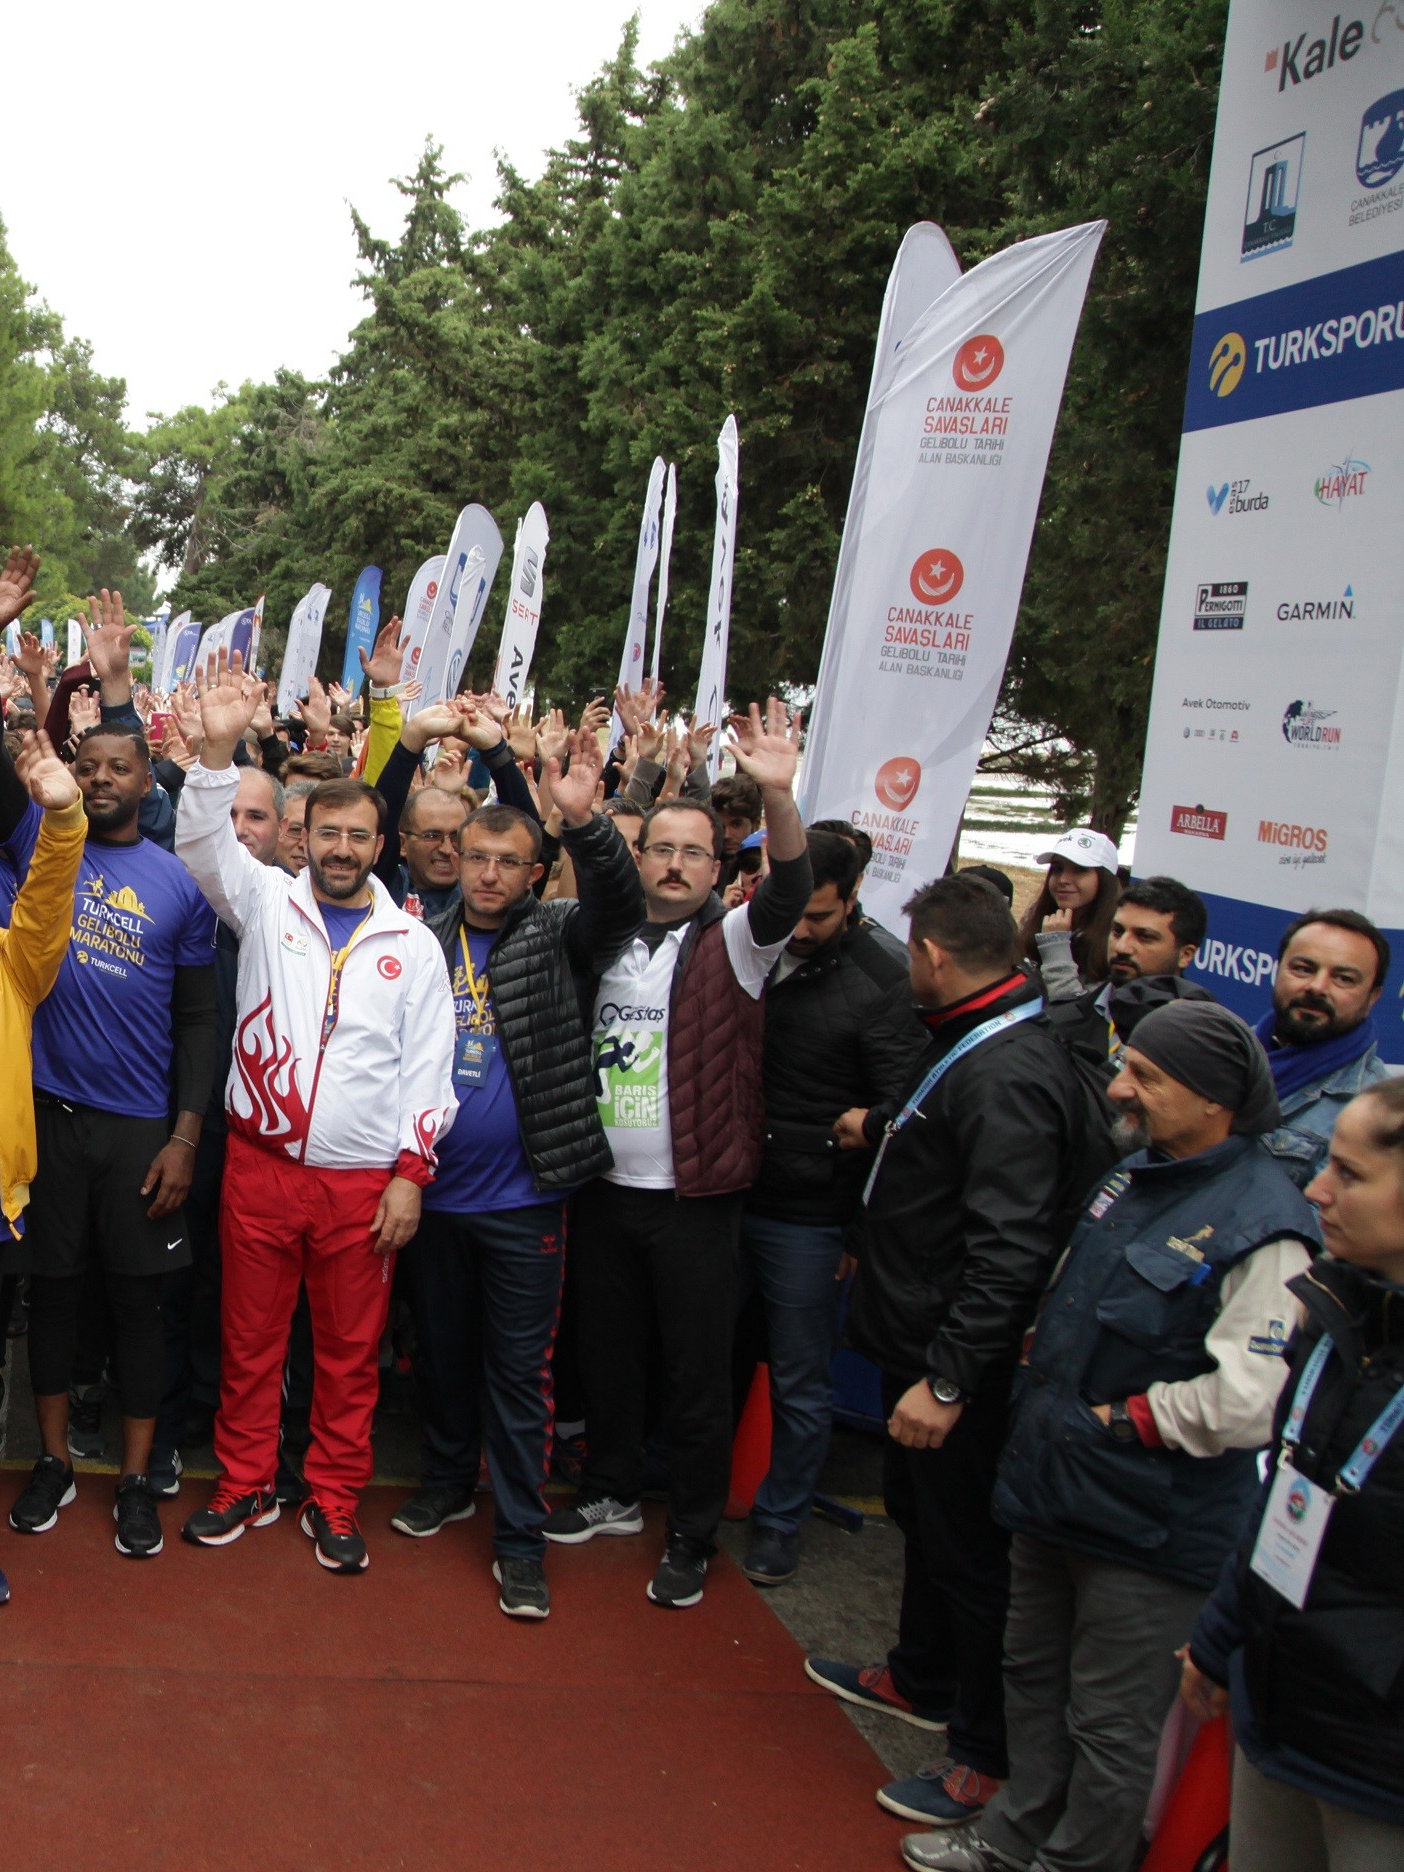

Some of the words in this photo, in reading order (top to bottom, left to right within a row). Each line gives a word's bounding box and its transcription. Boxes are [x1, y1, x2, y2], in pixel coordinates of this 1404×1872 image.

[1278, 14, 1365, 93] Kale
[923, 415, 1008, 435] SAVAŞLARI
[919, 437, 968, 449] GELİBOLU
[974, 438, 1004, 451] TARİHİ
[918, 453, 942, 464] ALAN
[1237, 479, 1251, 494] 17
[1320, 471, 1368, 500] HAYAT
[1235, 491, 1270, 513] burda
[1219, 585, 1239, 594] 1860
[1277, 600, 1354, 621] GARMIN
[1208, 619, 1239, 628] GELATO
[884, 625, 970, 652] SAVAŞLARI
[880, 645, 931, 662] GELİBOLU
[937, 651, 966, 667] TARİHİ
[878, 660, 903, 673] ALAN
[1181, 697, 1203, 709] Avek
[1205, 698, 1251, 711] Otomotiv
[1177, 813, 1220, 833] ARBELLA
[82, 897, 144, 935] TURKCELL
[69, 926, 145, 966] MARATONU
[91, 957, 128, 977] TURKCELL
[457, 1068, 482, 1078] DAVETLİ
